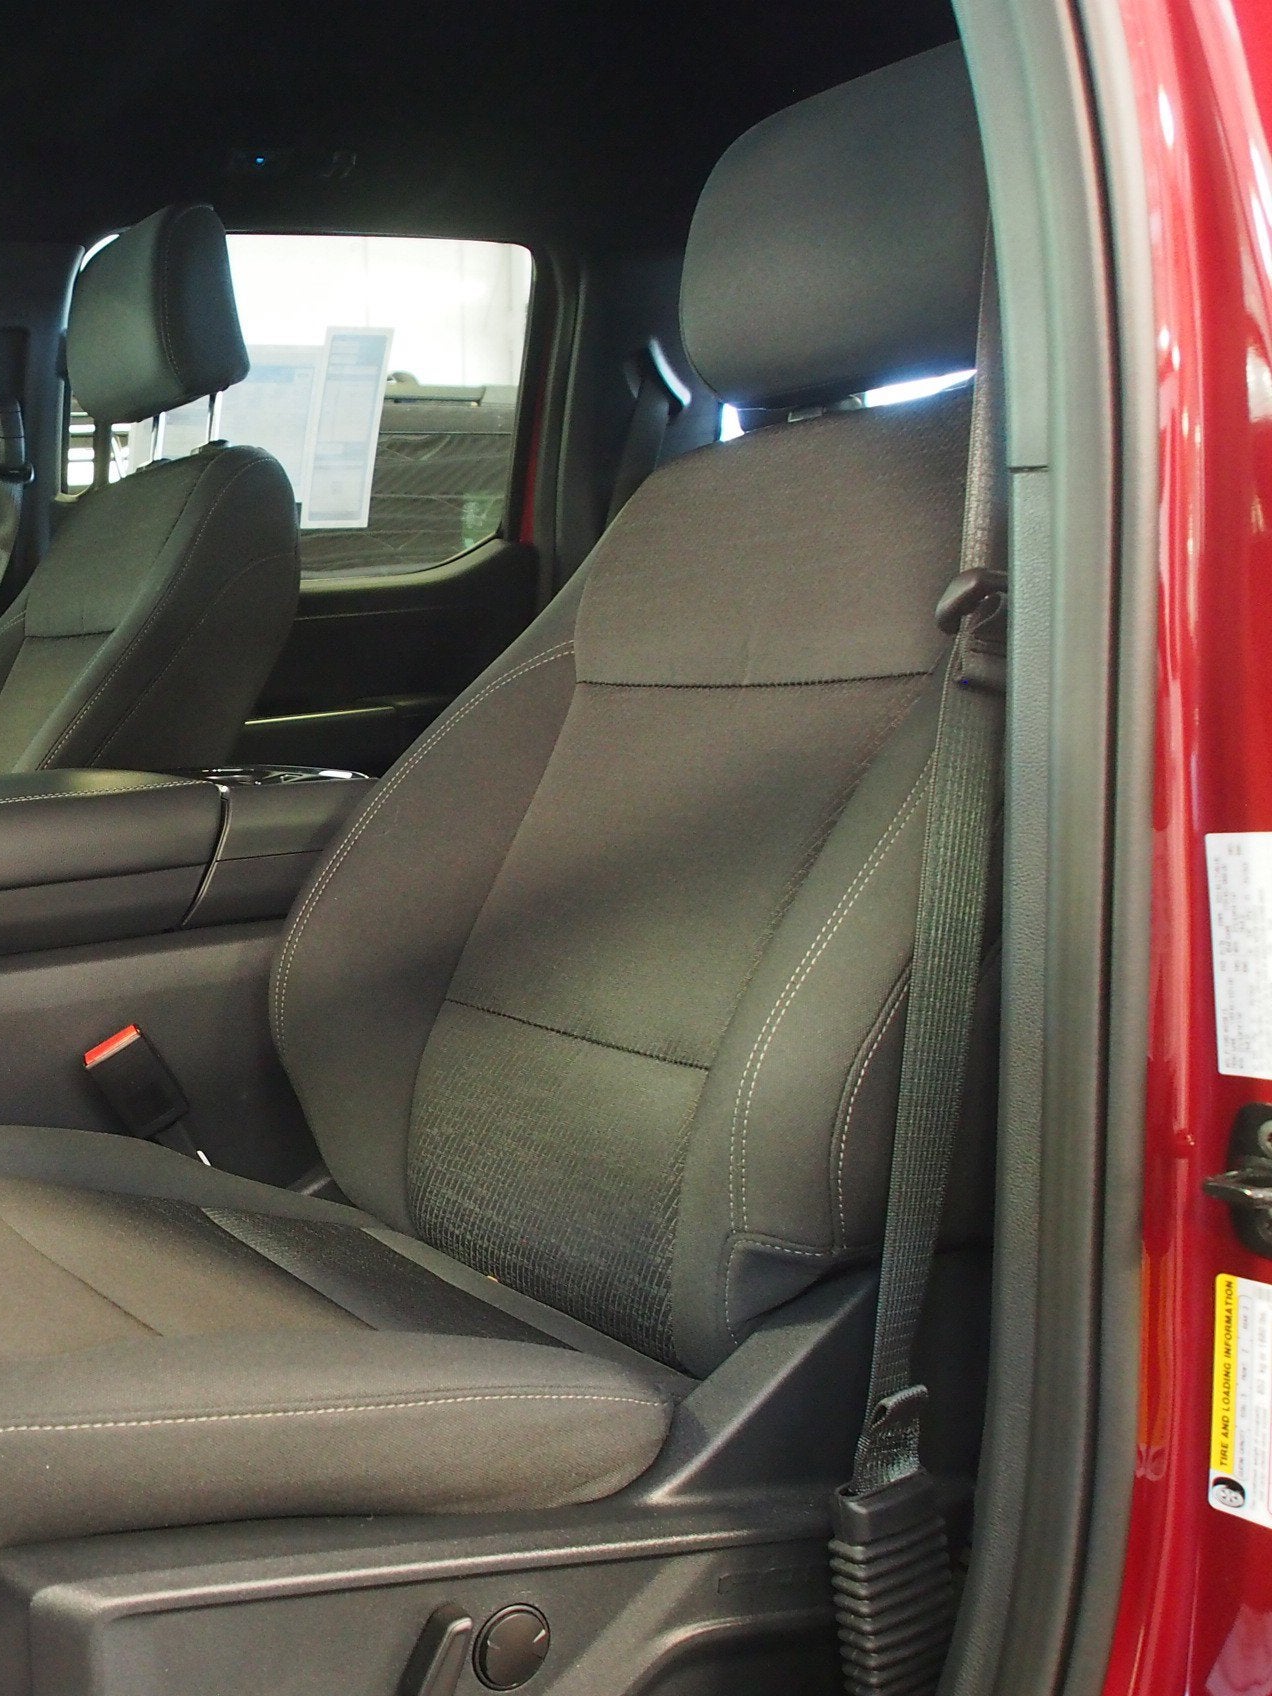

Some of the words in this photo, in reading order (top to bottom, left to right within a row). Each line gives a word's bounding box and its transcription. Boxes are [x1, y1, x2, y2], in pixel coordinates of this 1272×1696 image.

[1224, 1281, 1233, 1358] INFORMATION
[1222, 1363, 1232, 1411] LOADING
[1221, 1415, 1230, 1438] AND
[1219, 1442, 1229, 1466] TIRE
